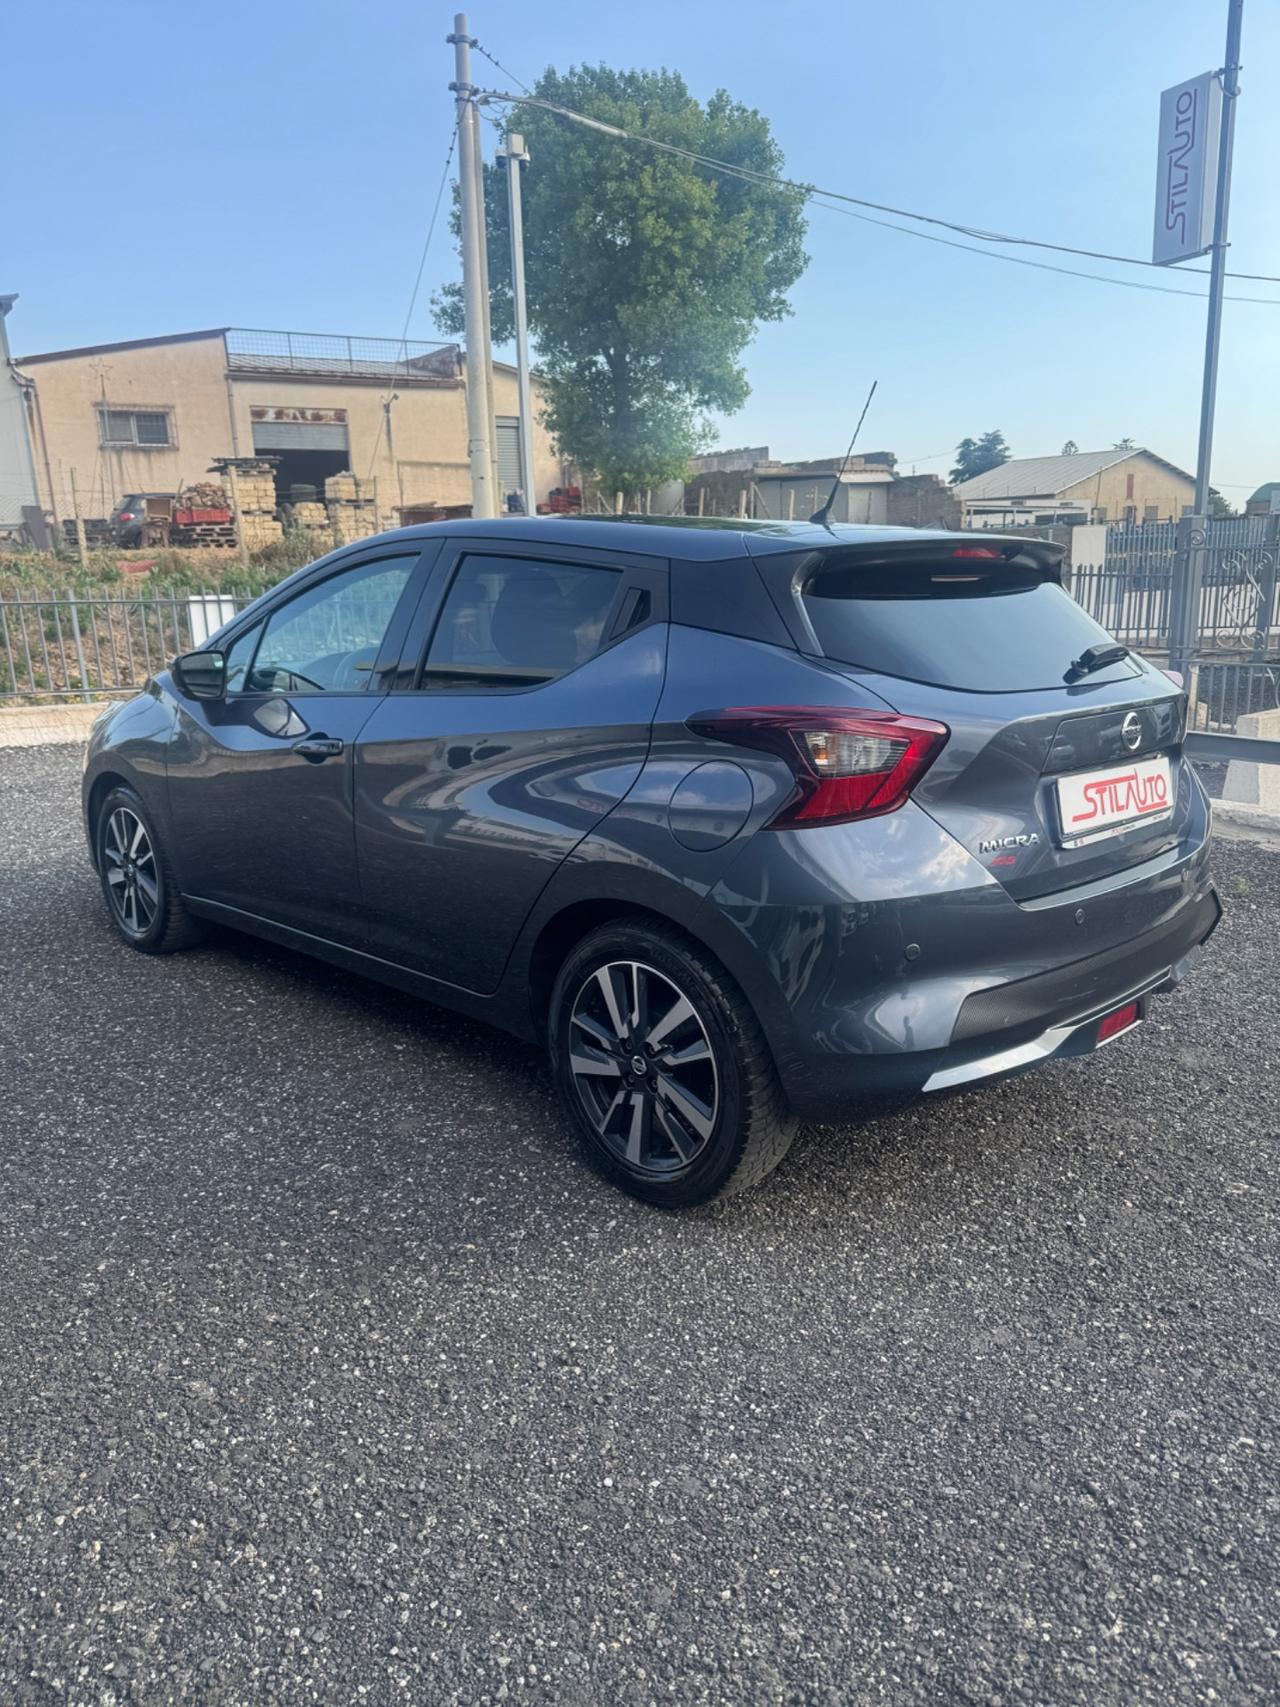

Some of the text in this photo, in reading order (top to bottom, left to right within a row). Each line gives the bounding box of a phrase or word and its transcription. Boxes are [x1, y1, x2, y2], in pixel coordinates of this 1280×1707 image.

[1166, 88, 1198, 245] STILAUTO
[1072, 768, 1168, 823] STILAUTO
[979, 833, 1039, 854] MICRA
